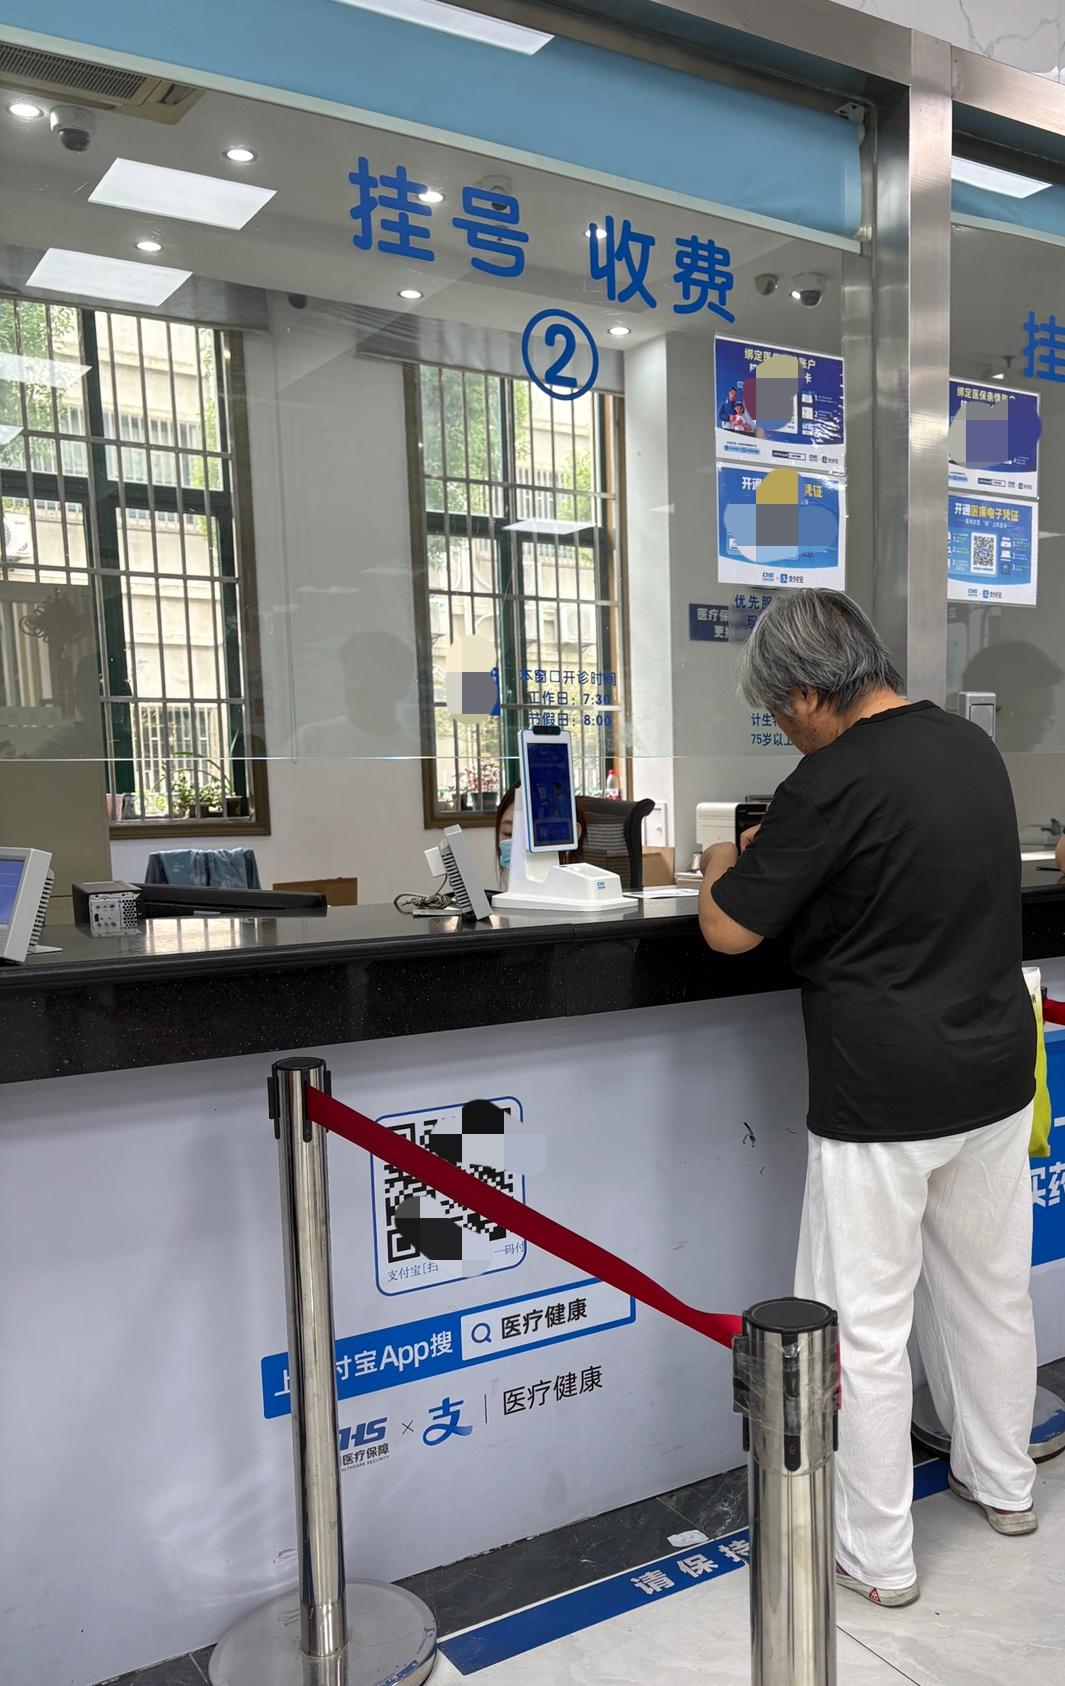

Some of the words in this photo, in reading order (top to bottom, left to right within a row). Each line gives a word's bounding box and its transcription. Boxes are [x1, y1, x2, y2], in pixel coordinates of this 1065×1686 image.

[348, 156, 529, 278] 挂号
[588, 215, 736, 323] 收费
[735, 594, 782, 610] 优先服
[519, 669, 616, 686] 本窗口开诊时间
[751, 712, 777, 727] 计生
[501, 1297, 588, 1340] 医疗健康
[503, 1365, 603, 1416] 医疗健康
